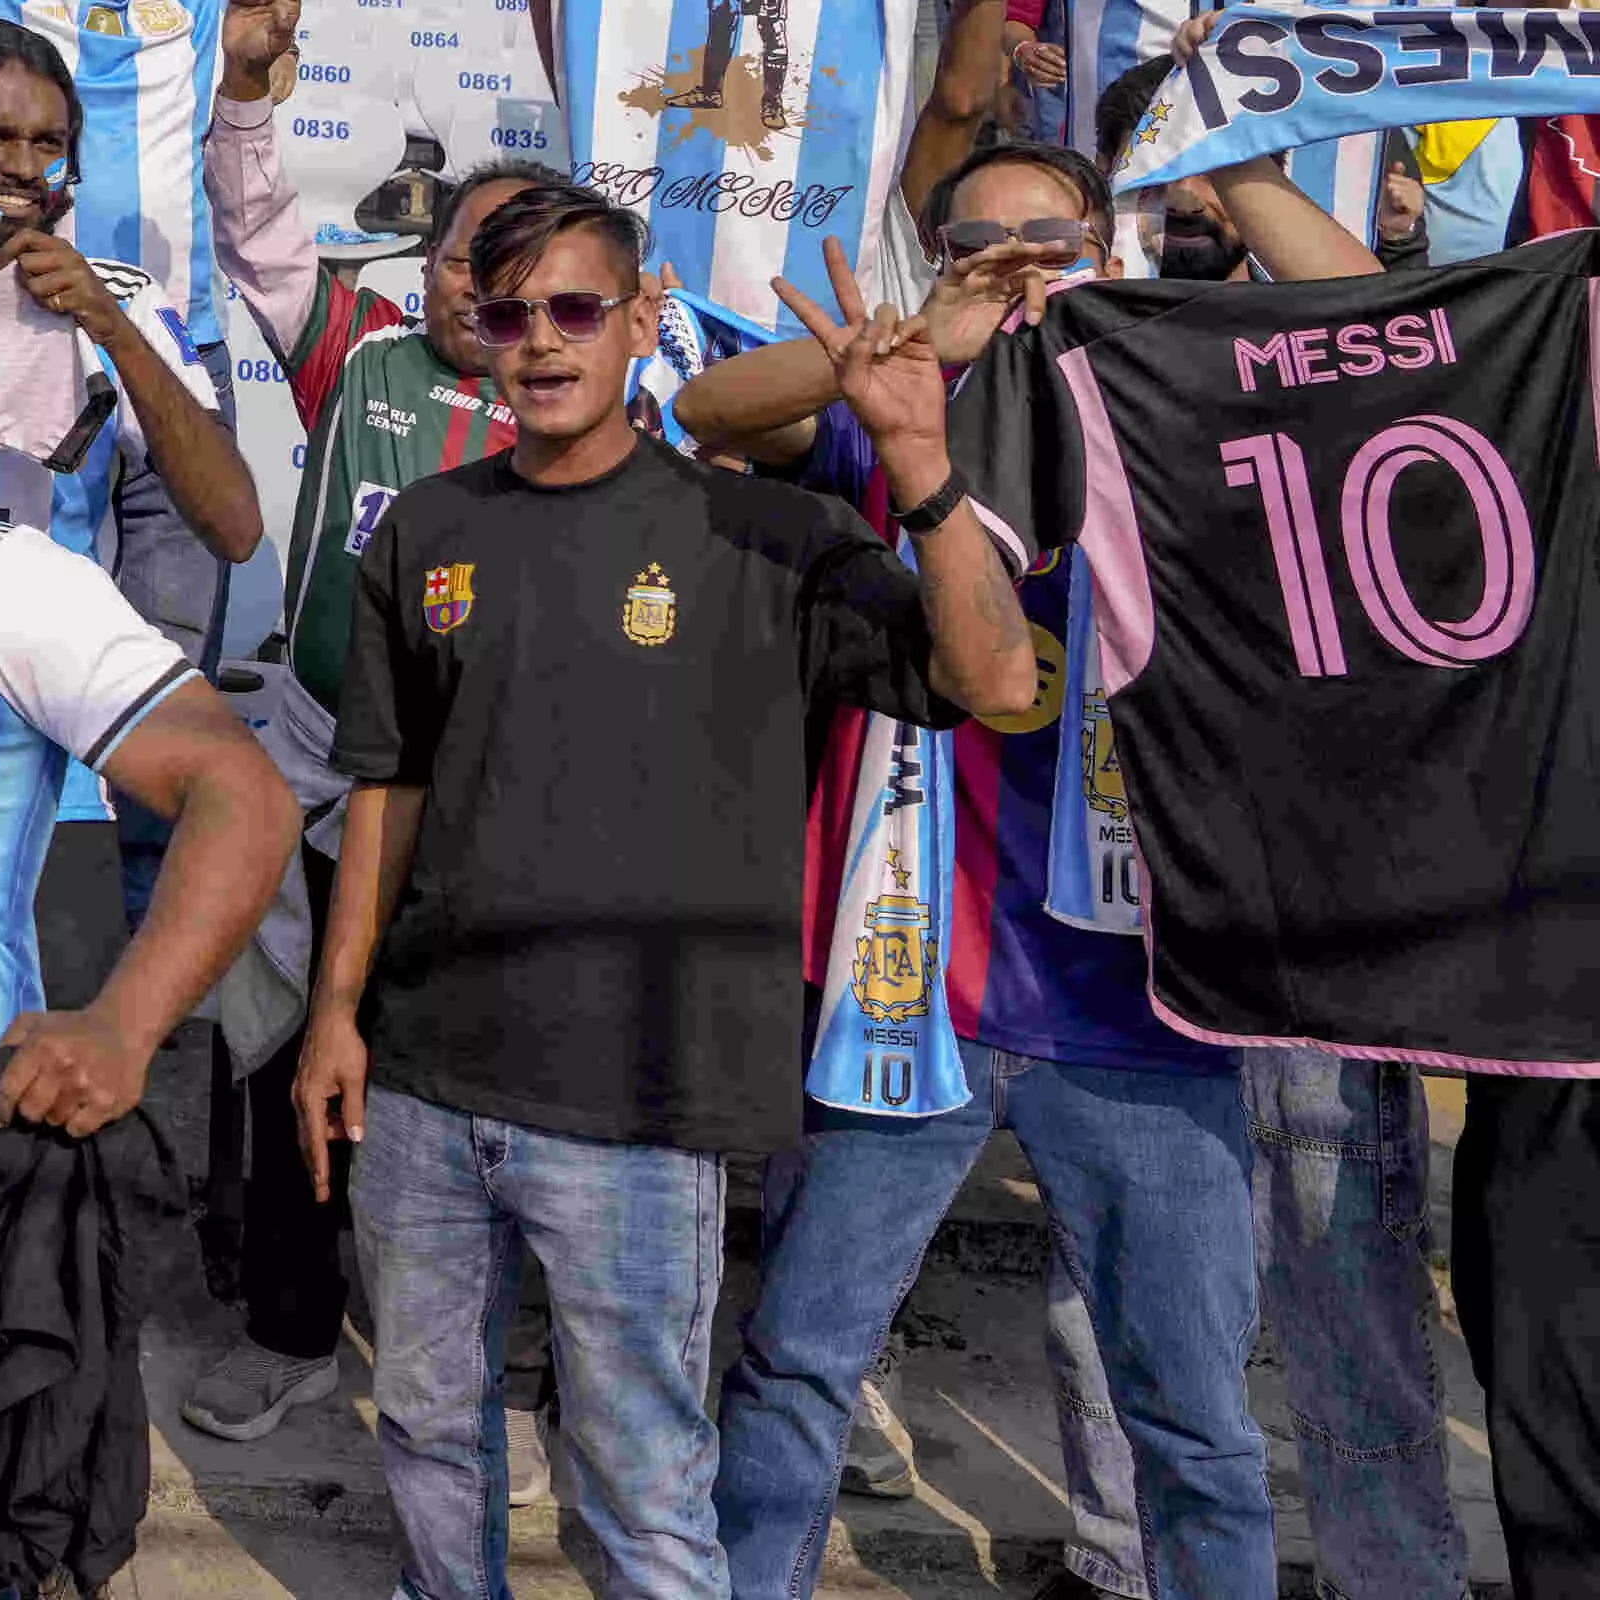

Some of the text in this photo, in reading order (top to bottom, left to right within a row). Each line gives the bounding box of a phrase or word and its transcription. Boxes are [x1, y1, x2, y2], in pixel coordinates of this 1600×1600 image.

[410, 31, 460, 49] 0864
[299, 64, 351, 84] 0860
[458, 71, 513, 92] 0861
[293, 118, 350, 140] 0836
[491, 127, 548, 150] 0835
[1232, 307, 1457, 393] MESSI
[1218, 414, 1537, 679] 10
[863, 1027, 920, 1050] MESSI
[861, 1052, 913, 1107] 10
